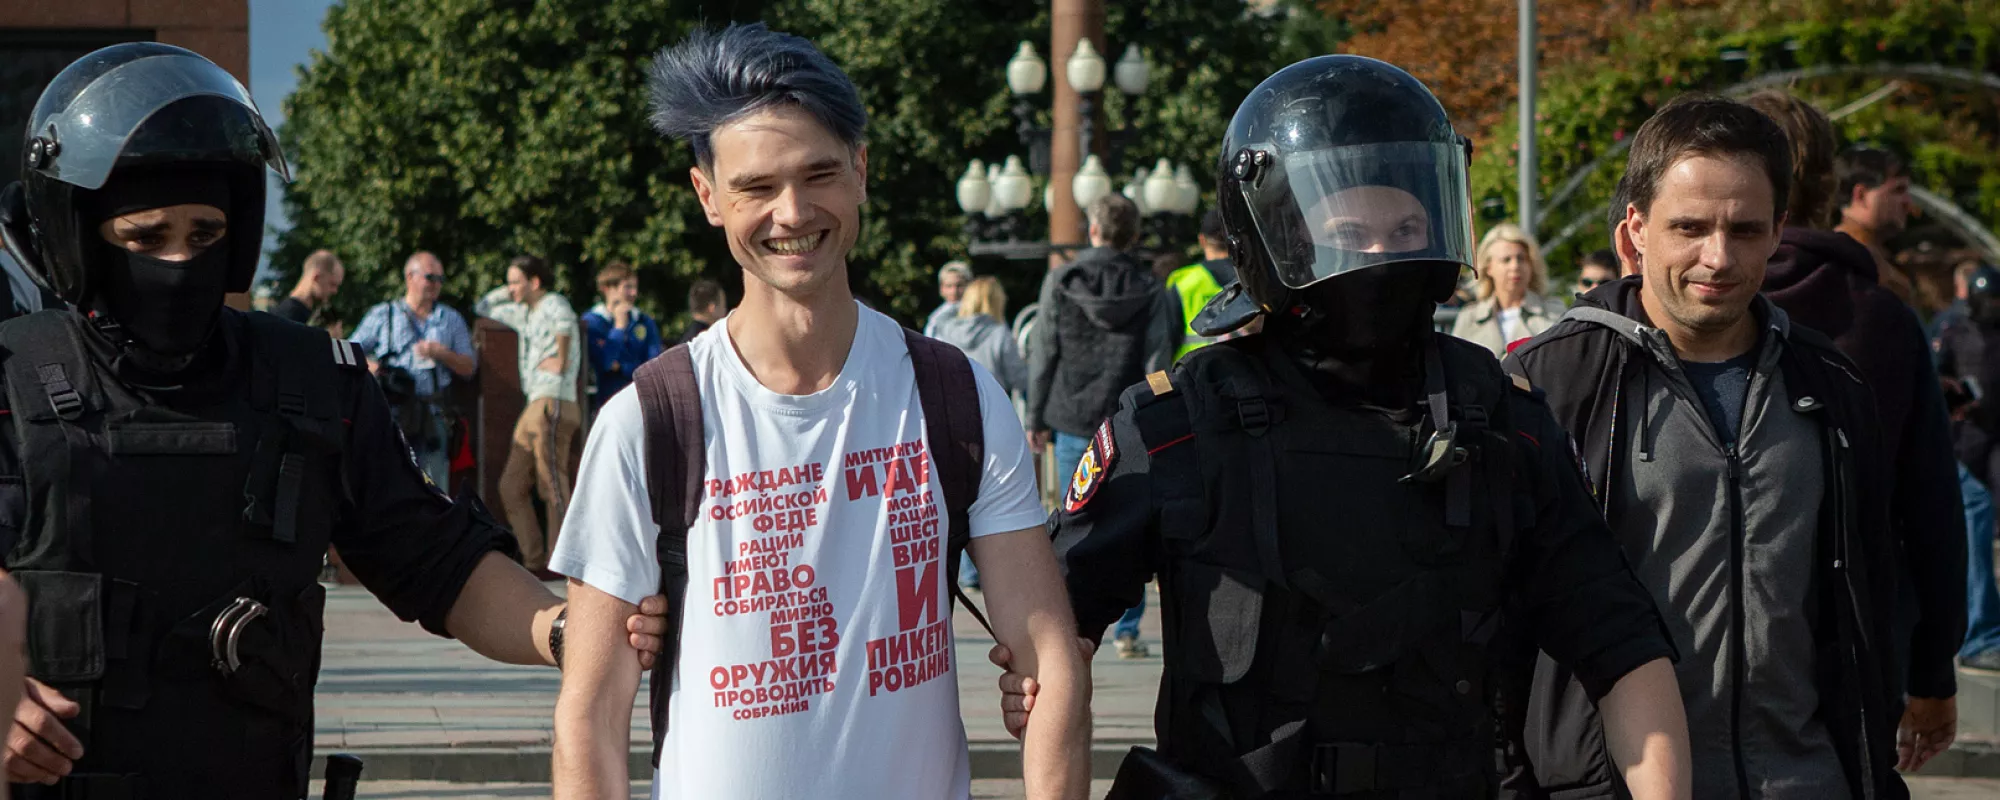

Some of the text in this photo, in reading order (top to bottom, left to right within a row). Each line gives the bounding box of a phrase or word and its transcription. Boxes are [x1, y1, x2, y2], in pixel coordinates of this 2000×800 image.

[844, 438, 924, 468] МИТИНГИ
[704, 462, 824, 498] РАЖДАНЕ
[845, 451, 930, 502] И ДЕ
[708, 485, 828, 522] ОССИЙСКОЙ
[886, 490, 934, 513] МОНСТ
[888, 504, 938, 527] РАЦИИ
[752, 508, 818, 533] ФЕДЕ
[889, 518, 939, 545] ШЕСТ
[739, 533, 804, 556] РАЦИИ
[892, 536, 940, 568] ВИЯ
[724, 552, 789, 575] ИМЕЮТ
[713, 564, 815, 600] ПРАВО
[895, 560, 939, 632] И
[714, 586, 828, 617] СОБИРАТЬСЯ
[770, 602, 834, 625] МИРНО
[770, 616, 840, 658] БЕЗ
[709, 650, 838, 690] ОРУЖИЯ
[869, 647, 950, 697] РОВАНИЕ
[714, 677, 835, 707] ПРОВОДИТЬ
[733, 700, 809, 720] СОБРАНИЯ
